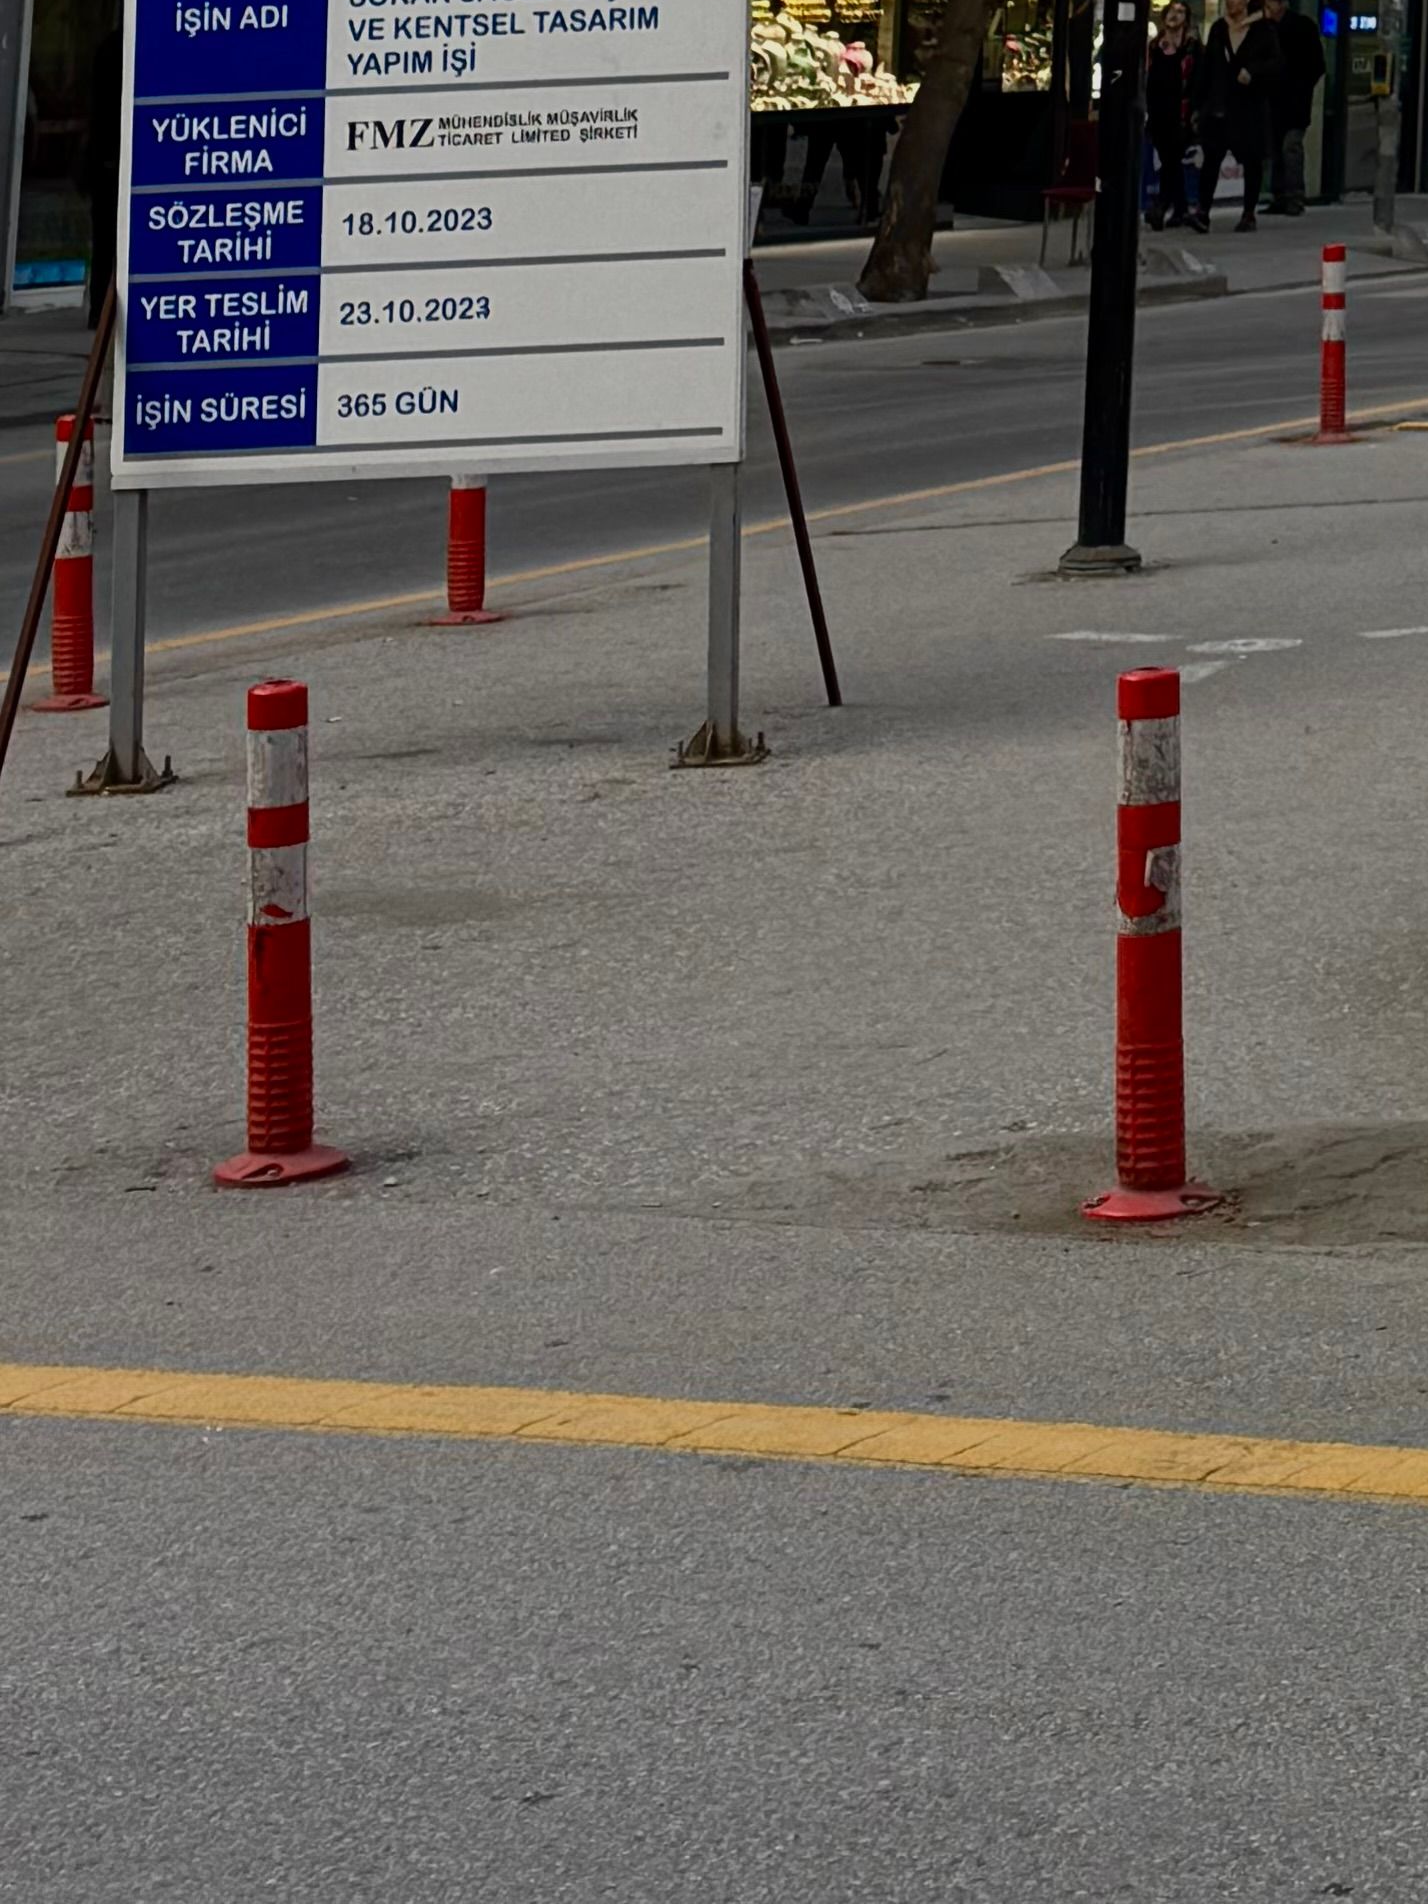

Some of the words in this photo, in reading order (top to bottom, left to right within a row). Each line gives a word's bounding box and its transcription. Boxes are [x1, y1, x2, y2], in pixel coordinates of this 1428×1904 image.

[175, 3, 233, 38] İŞİN
[239, 5, 289, 30] ADI
[348, 18, 386, 42] VE
[393, 11, 525, 41] KENTSEL
[532, 6, 659, 34] TASARIM
[347, 50, 433, 76] YAPIM
[442, 43, 477, 77] İŞİ
[152, 107, 307, 142] YÜKLENİCİ
[346, 118, 436, 152] FMZ
[438, 110, 542, 131] MÜHENDİSLİK
[546, 107, 639, 127] MÜŞAVİRLİK
[437, 128, 504, 148] TİCARET
[511, 125, 571, 145] LİMİTED
[578, 122, 639, 145] ŞİRKETİ
[184, 146, 274, 176] FİRMA
[148, 199, 304, 232] SÖZLEŞME
[341, 207, 494, 237] 18.10.2023
[178, 231, 272, 265] TARİHİ
[140, 295, 196, 320] YER
[204, 283, 309, 317] TESLİM
[177, 320, 271, 355] TARİHİ
[136, 394, 192, 431] İŞİN
[200, 387, 307, 423] SÜRESİ
[337, 393, 387, 418] 365
[394, 387, 459, 416] GÜN
